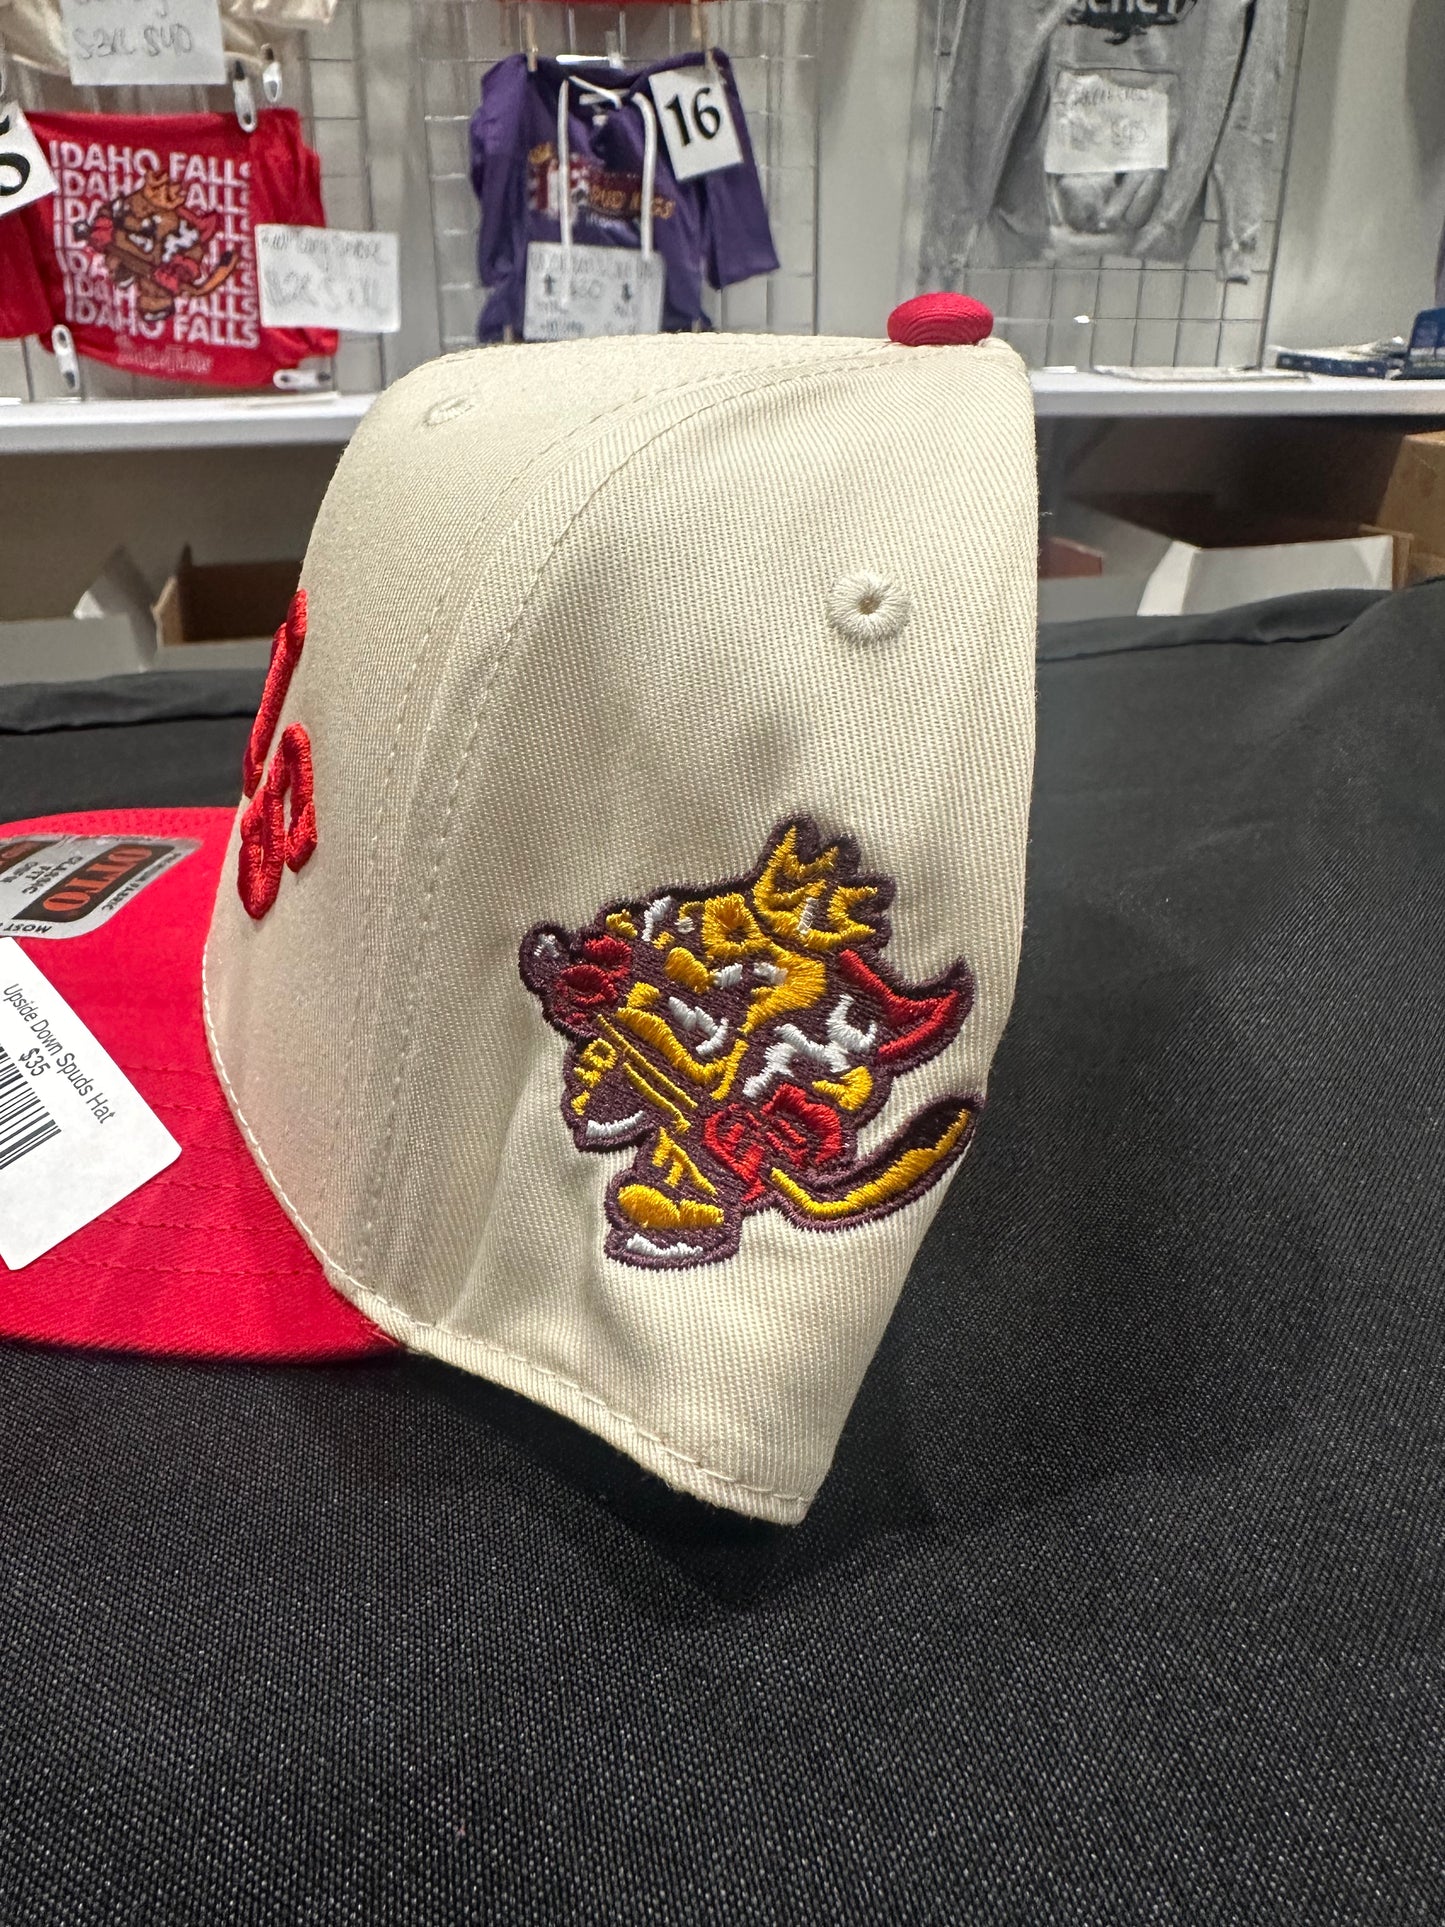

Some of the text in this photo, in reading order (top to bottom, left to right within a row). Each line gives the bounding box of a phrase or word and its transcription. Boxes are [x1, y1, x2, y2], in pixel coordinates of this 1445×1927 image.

[664, 86, 721, 147] 16
[48, 140, 161, 175] IDAHO
[173, 313, 261, 350] FALLS
[22, 856, 84, 894] CLASSIC
[43, 847, 153, 912] OTTO
[3, 923, 52, 933] MOST
[3, 983, 116, 1124] Upside Down Spuds Hat
[18, 1047, 51, 1077] $35
